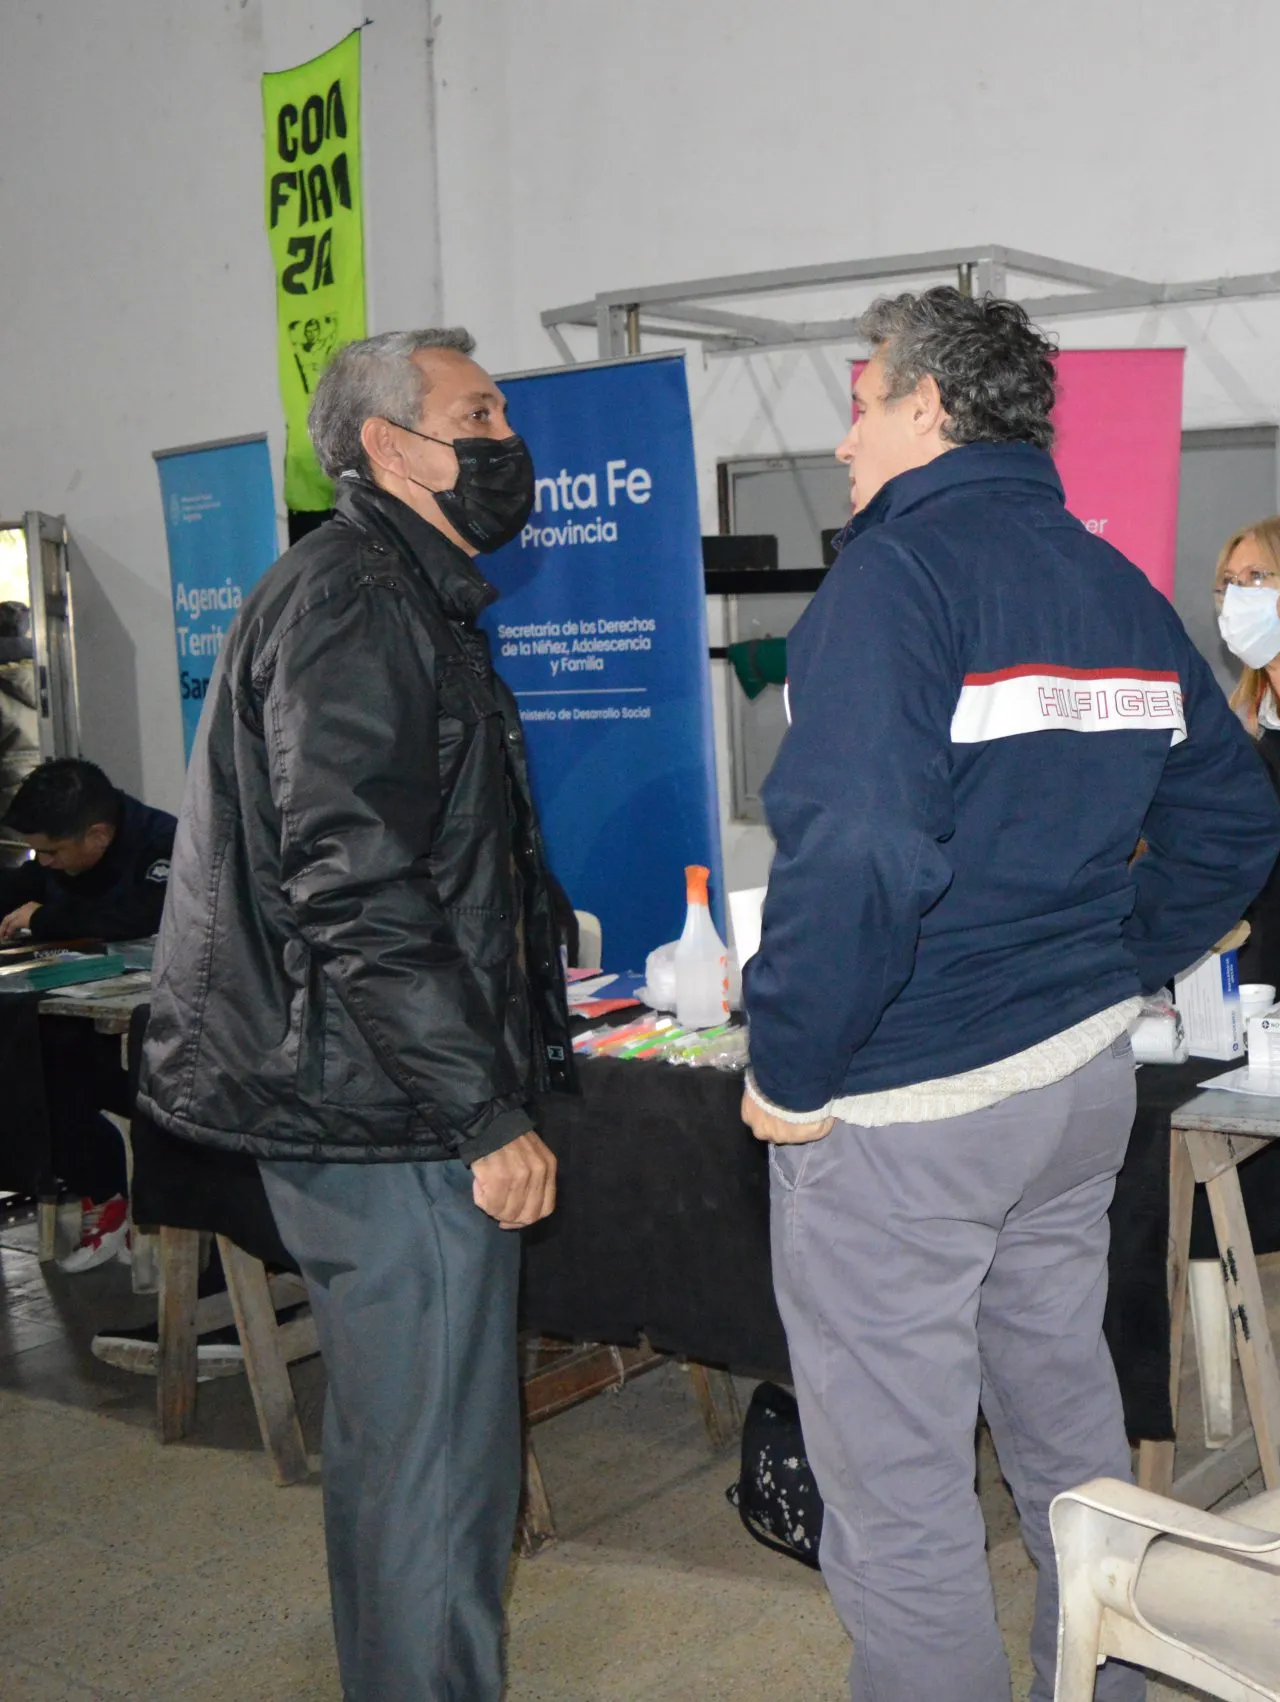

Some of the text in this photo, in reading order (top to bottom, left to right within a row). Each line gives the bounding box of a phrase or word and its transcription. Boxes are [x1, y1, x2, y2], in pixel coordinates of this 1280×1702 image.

[534, 459, 652, 513] nta Fe
[520, 515, 618, 549] Provincia
[175, 577, 242, 619] Agencia
[562, 617, 578, 636] de
[579, 618, 598, 635] los
[598, 616, 656, 634] Derechos
[501, 641, 518, 657] de
[519, 640, 532, 656] la
[571, 634, 652, 654] Adolescencia
[550, 655, 605, 678] y Familia
[557, 707, 571, 720] de
[572, 707, 622, 720] Desarrollo
[622, 706, 652, 720] Social
